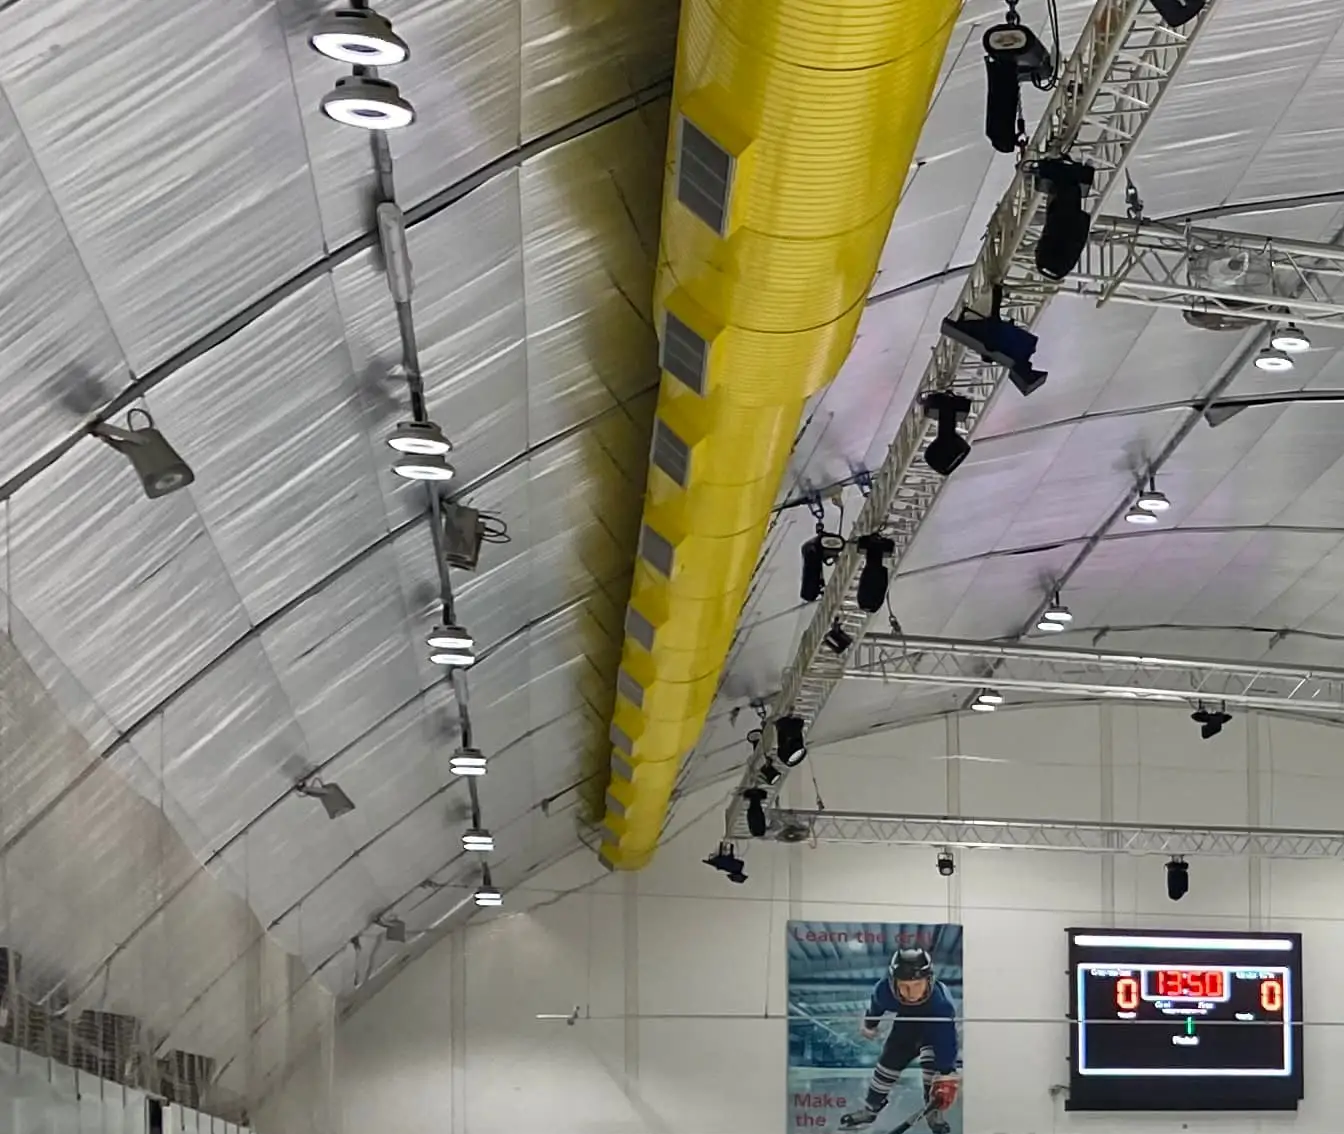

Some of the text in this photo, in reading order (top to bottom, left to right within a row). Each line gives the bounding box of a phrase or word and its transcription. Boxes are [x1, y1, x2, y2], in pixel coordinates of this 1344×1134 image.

[794, 927, 848, 943] Learn
[856, 929, 886, 944] the
[1116, 978, 1138, 1010] 0
[1158, 970, 1223, 997] 13:50
[1260, 980, 1282, 1012] 0
[794, 1093, 848, 1109] Make
[796, 1111, 826, 1127] the
